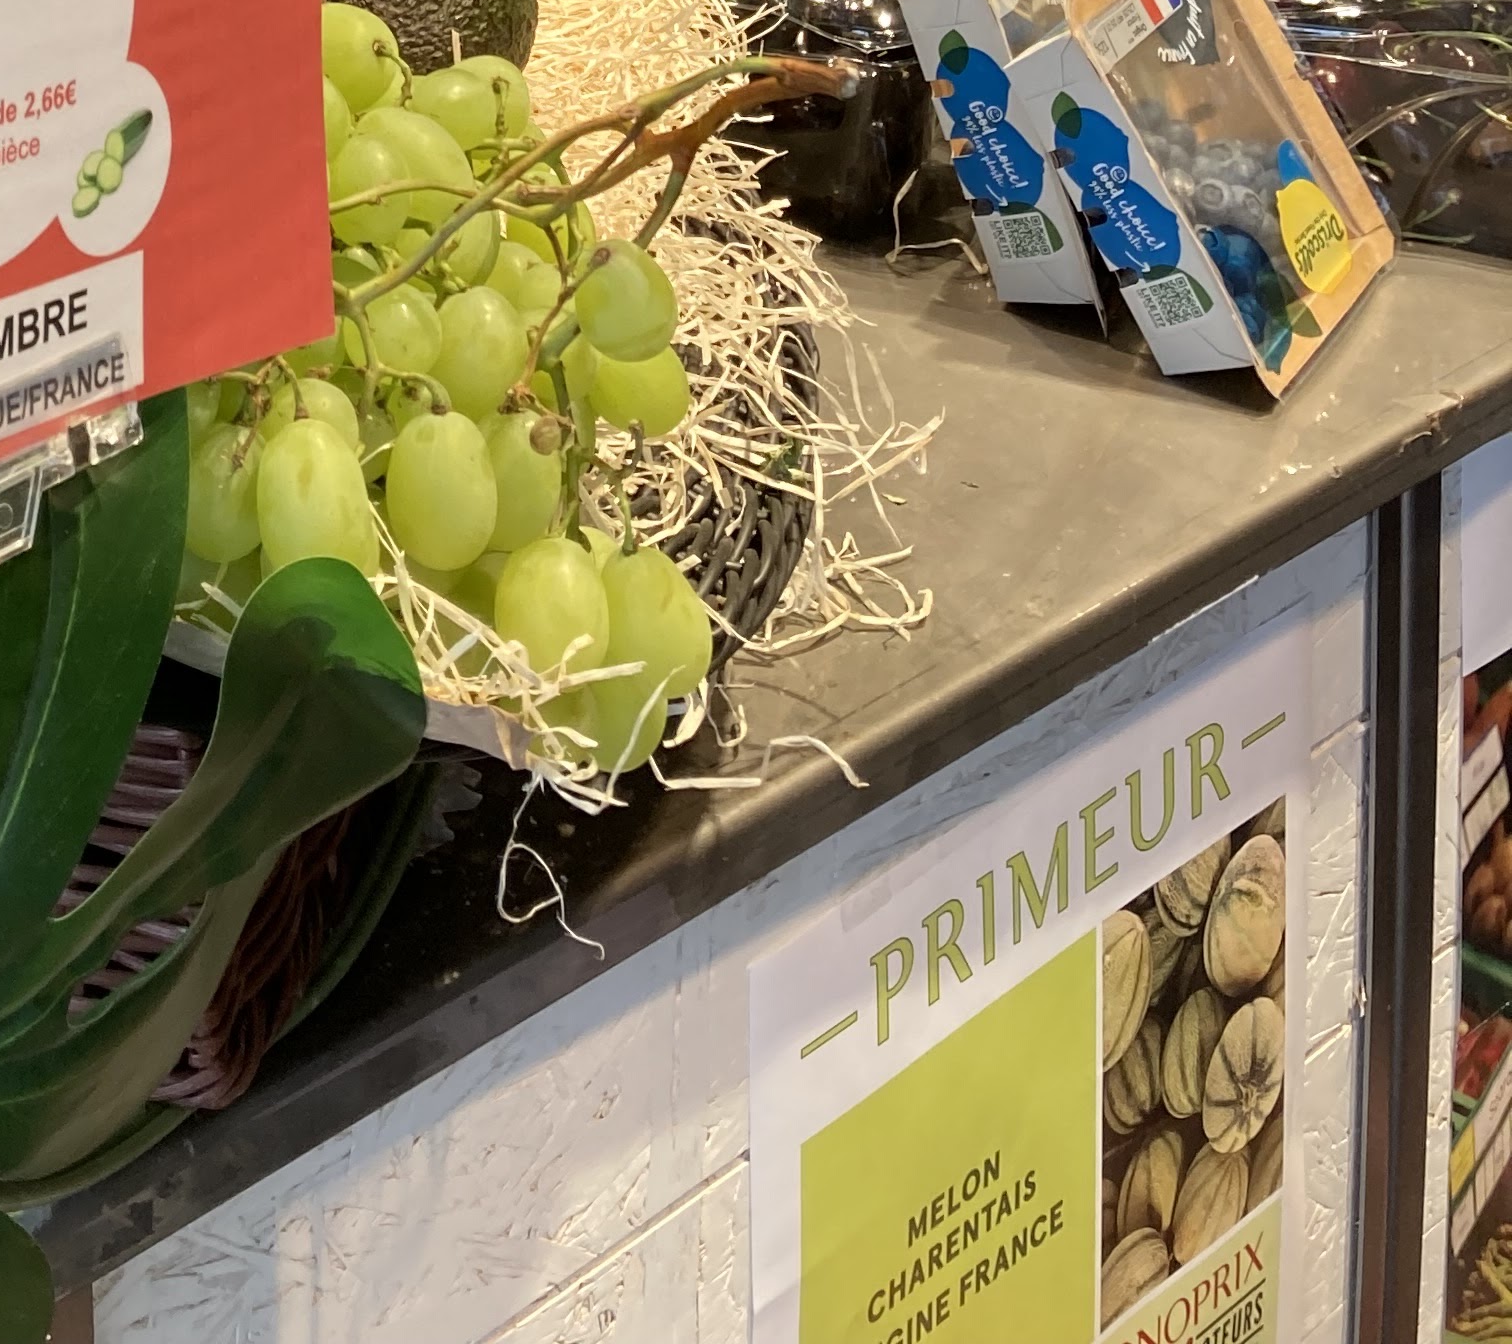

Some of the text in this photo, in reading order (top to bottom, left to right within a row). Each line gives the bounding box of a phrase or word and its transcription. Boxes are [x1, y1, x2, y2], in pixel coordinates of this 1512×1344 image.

[23, 78, 78, 120] 2,66€
[968, 100, 998, 137] Good
[973, 133, 987, 156] less
[988, 137, 1030, 190] choice!
[979, 154, 1006, 189] plastic
[1091, 162, 1125, 201] Good
[1101, 200, 1119, 219] less
[1114, 218, 1144, 253] plastic
[1118, 195, 1167, 252] choice!
[869, 720, 1232, 1047] PRIMEUR
[907, 1148, 1003, 1249] MELON
[866, 1169, 1038, 1324] CHARENTAIS
[879, 1198, 1066, 1344] GINE FRANCE
[1121, 1230, 1266, 1344] NOPRIX
